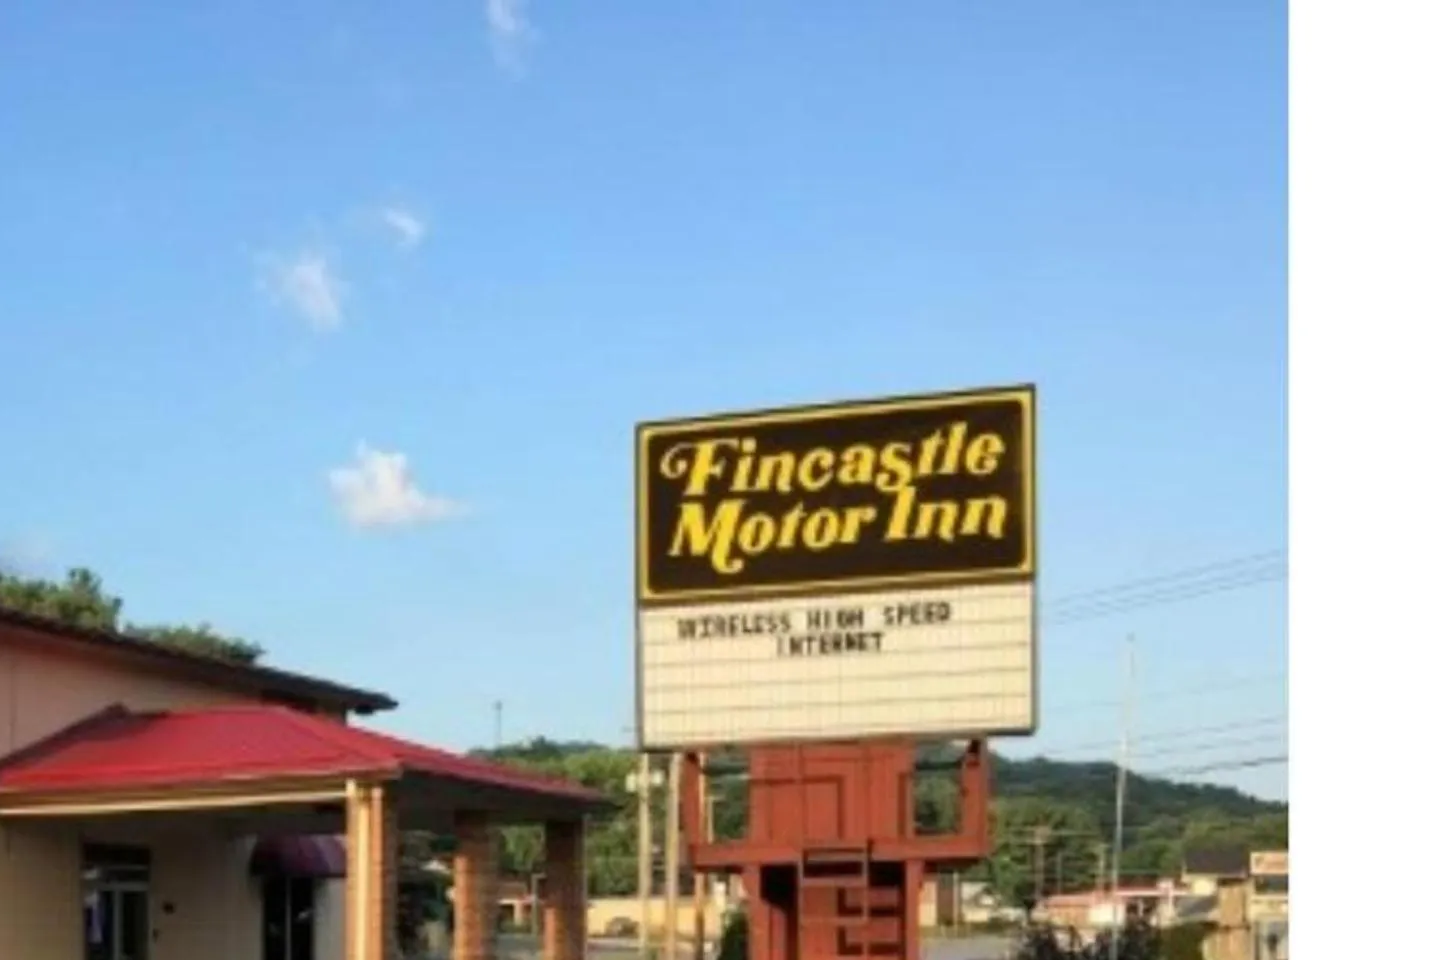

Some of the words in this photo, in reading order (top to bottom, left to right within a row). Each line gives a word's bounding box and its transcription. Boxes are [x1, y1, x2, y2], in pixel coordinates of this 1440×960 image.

[660, 421, 1005, 496] Fincastle
[667, 499, 877, 574] Motor
[883, 486, 1007, 542] Inn
[676, 611, 792, 639] WIRELESS
[807, 607, 865, 631] HIGH
[882, 601, 952, 626] SPEED
[776, 631, 885, 658] INTERNET
